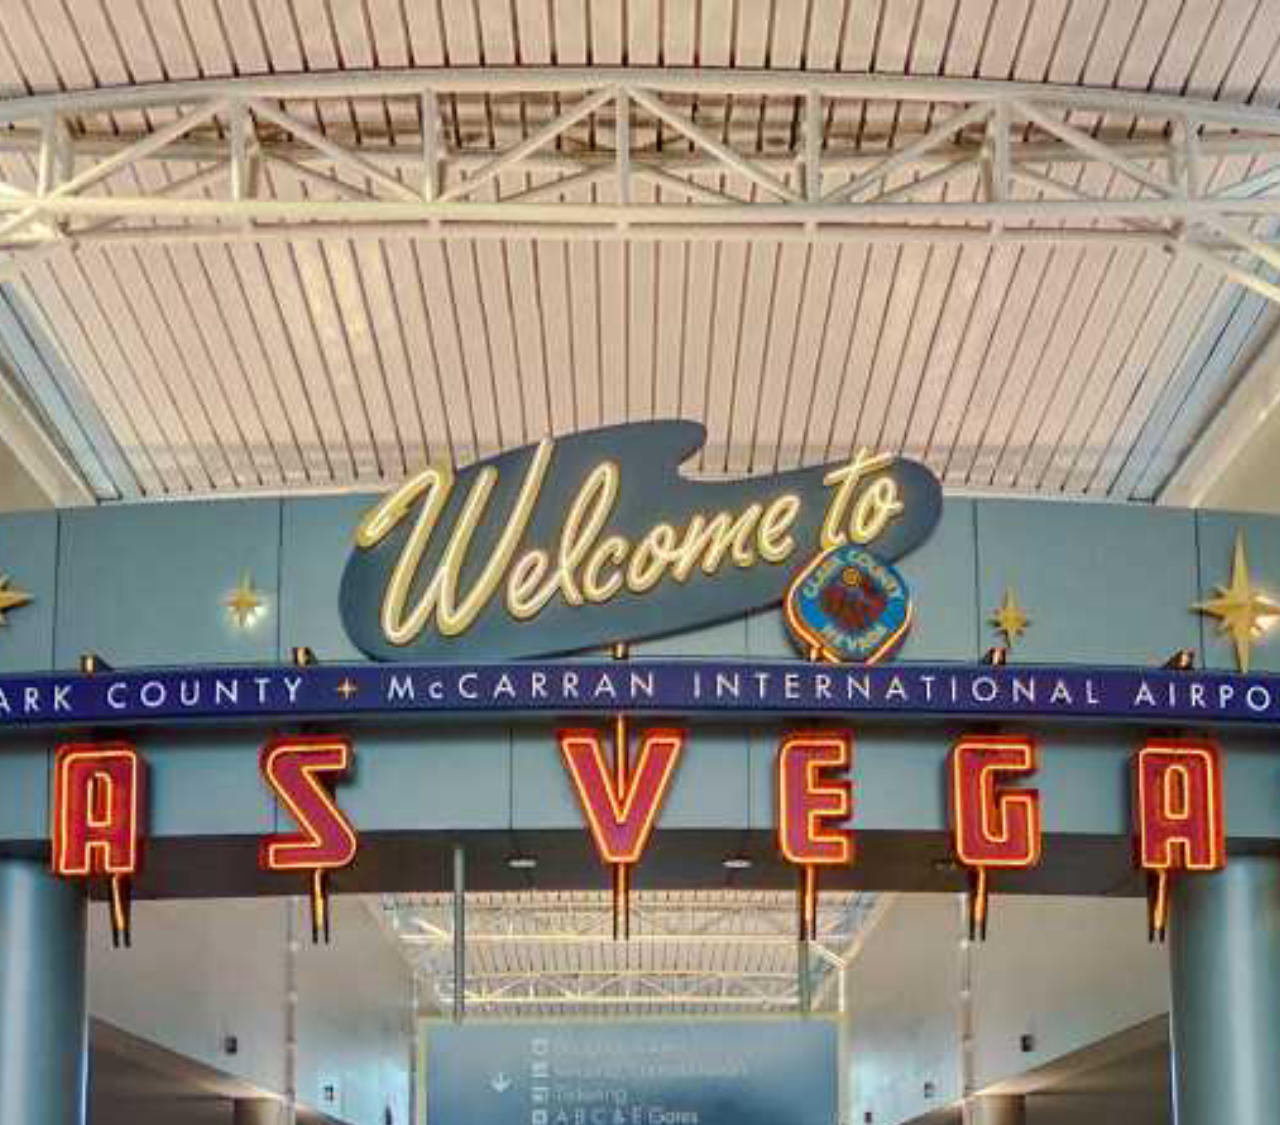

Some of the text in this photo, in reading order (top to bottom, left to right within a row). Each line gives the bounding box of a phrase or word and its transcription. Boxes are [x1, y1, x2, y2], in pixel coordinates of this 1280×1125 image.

[356, 437, 905, 647] Welcome to
[107, 677, 305, 710] COUNTY
[385, 670, 656, 702] McCARRAN
[693, 672, 1101, 706] INTERNATIONAL
